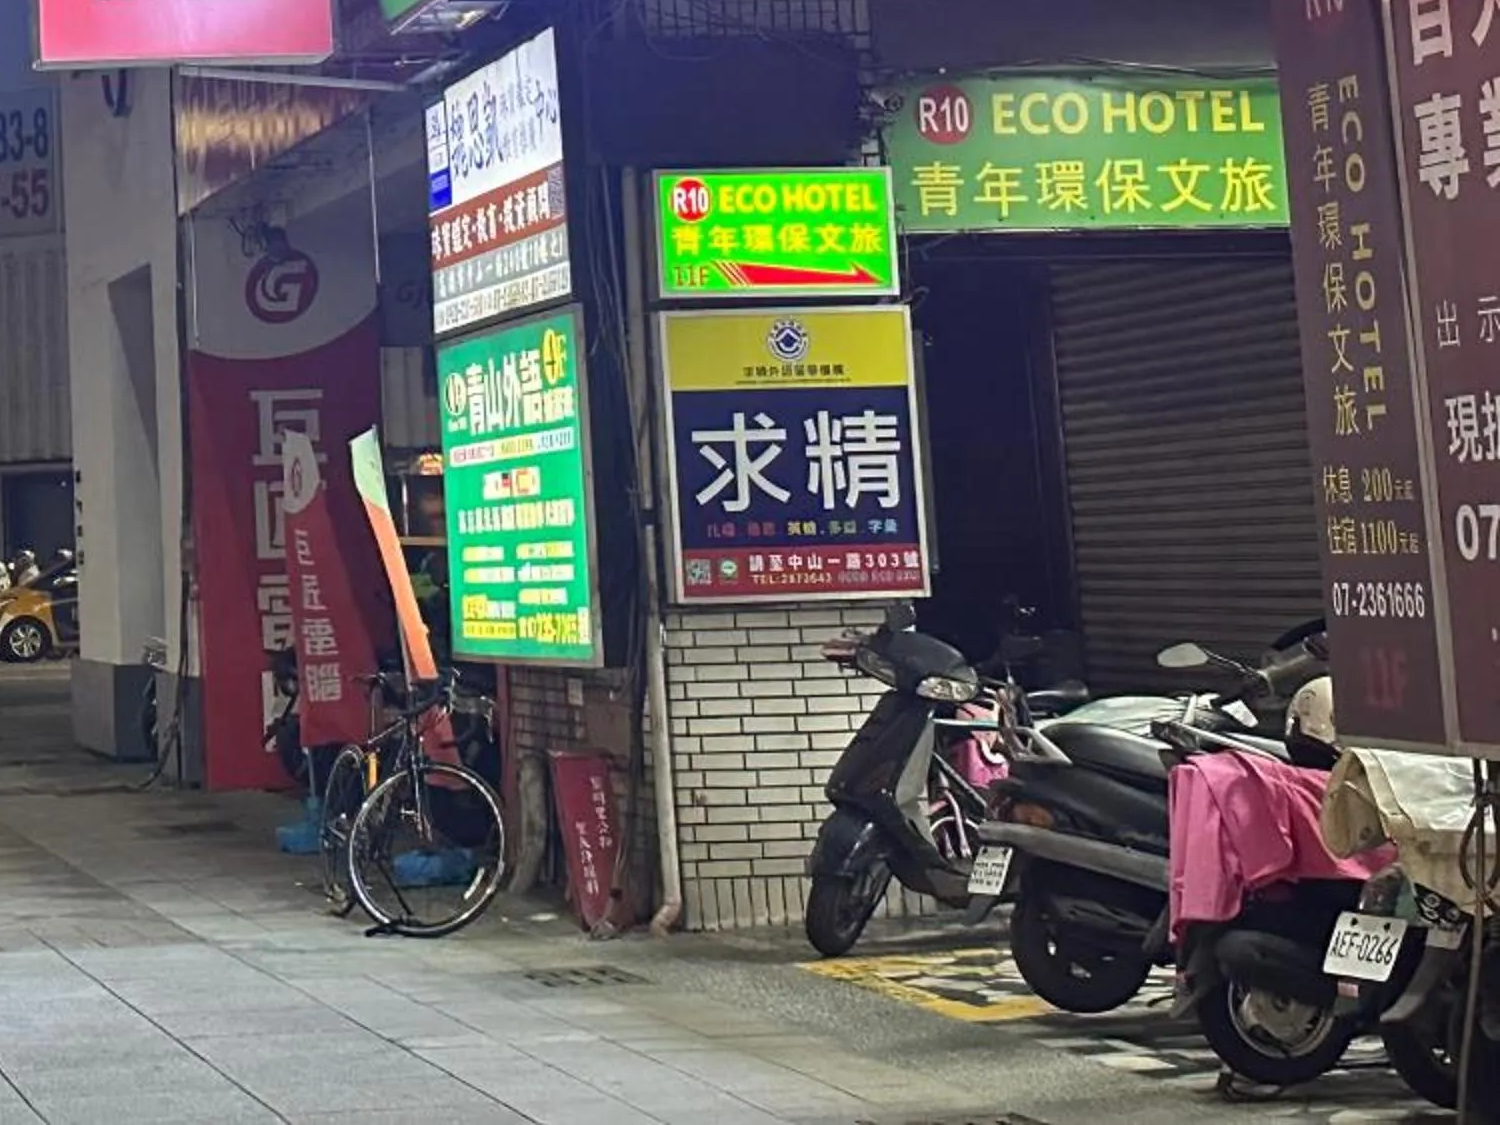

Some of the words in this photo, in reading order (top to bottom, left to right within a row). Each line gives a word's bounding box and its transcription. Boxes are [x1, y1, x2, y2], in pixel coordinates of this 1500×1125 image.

[918, 96, 970, 134] R10
[991, 91, 1090, 135] ECO
[1102, 89, 1266, 136] HOTEL
[1337, 74, 1367, 193] ECO
[672, 186, 710, 214] R10
[718, 184, 777, 213] ECO
[781, 182, 877, 213] HOTEL
[911, 156, 1278, 218] 青年環保文旅
[671, 223, 884, 257] 青年環保文旅
[1307, 81, 1360, 437] 青年環保文旅
[1349, 222, 1387, 432] HOTEL
[691, 409, 902, 513] 求精
[1323, 465, 1352, 504] 休息
[1327, 514, 1357, 555] 住宿
[1332, 581, 1426, 619] 07-2361666
[1331, 930, 1399, 966] AEF-0266
